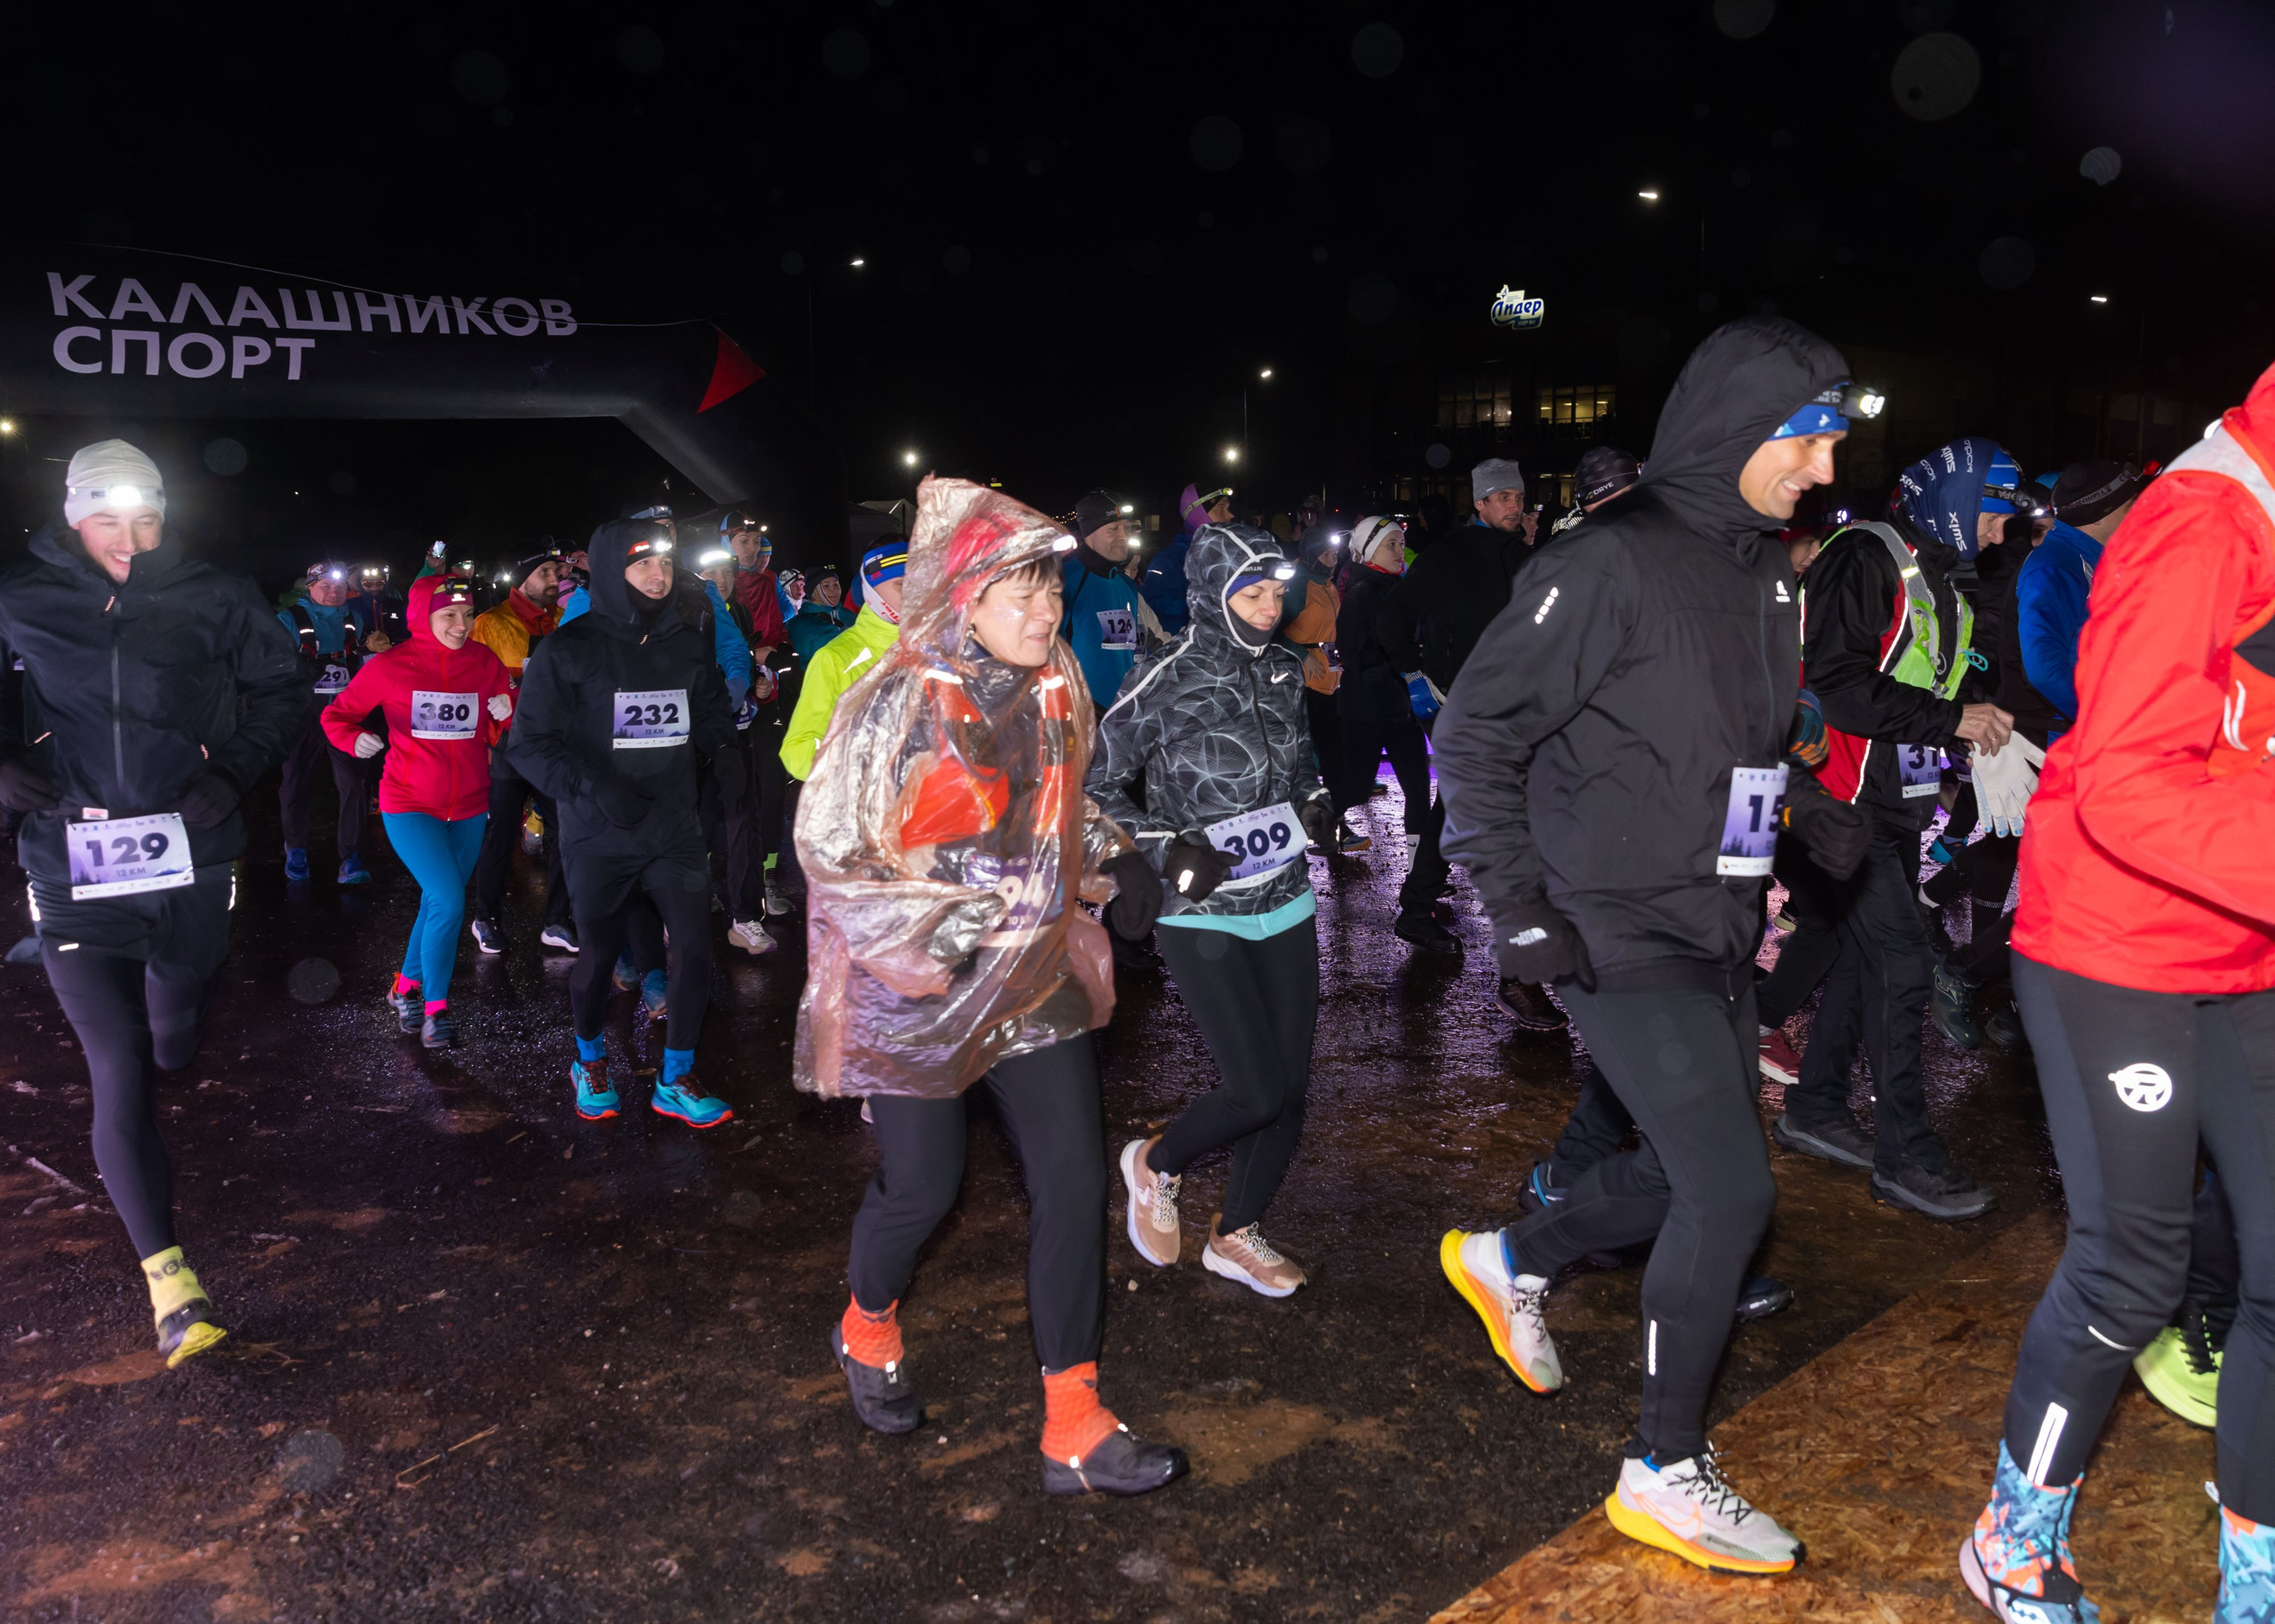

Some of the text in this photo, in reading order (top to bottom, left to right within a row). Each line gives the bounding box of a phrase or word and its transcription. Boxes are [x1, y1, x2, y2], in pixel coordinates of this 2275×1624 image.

[46, 272, 578, 337] КАЛАШНИКОВ
[52, 326, 315, 380] СПОРТ
[419, 702, 470, 721] 380
[622, 703, 679, 726] 232
[85, 832, 169, 867] 129
[1224, 822, 1291, 861] 309
[116, 869, 126, 878] 12
[1252, 862, 1261, 871] 12
